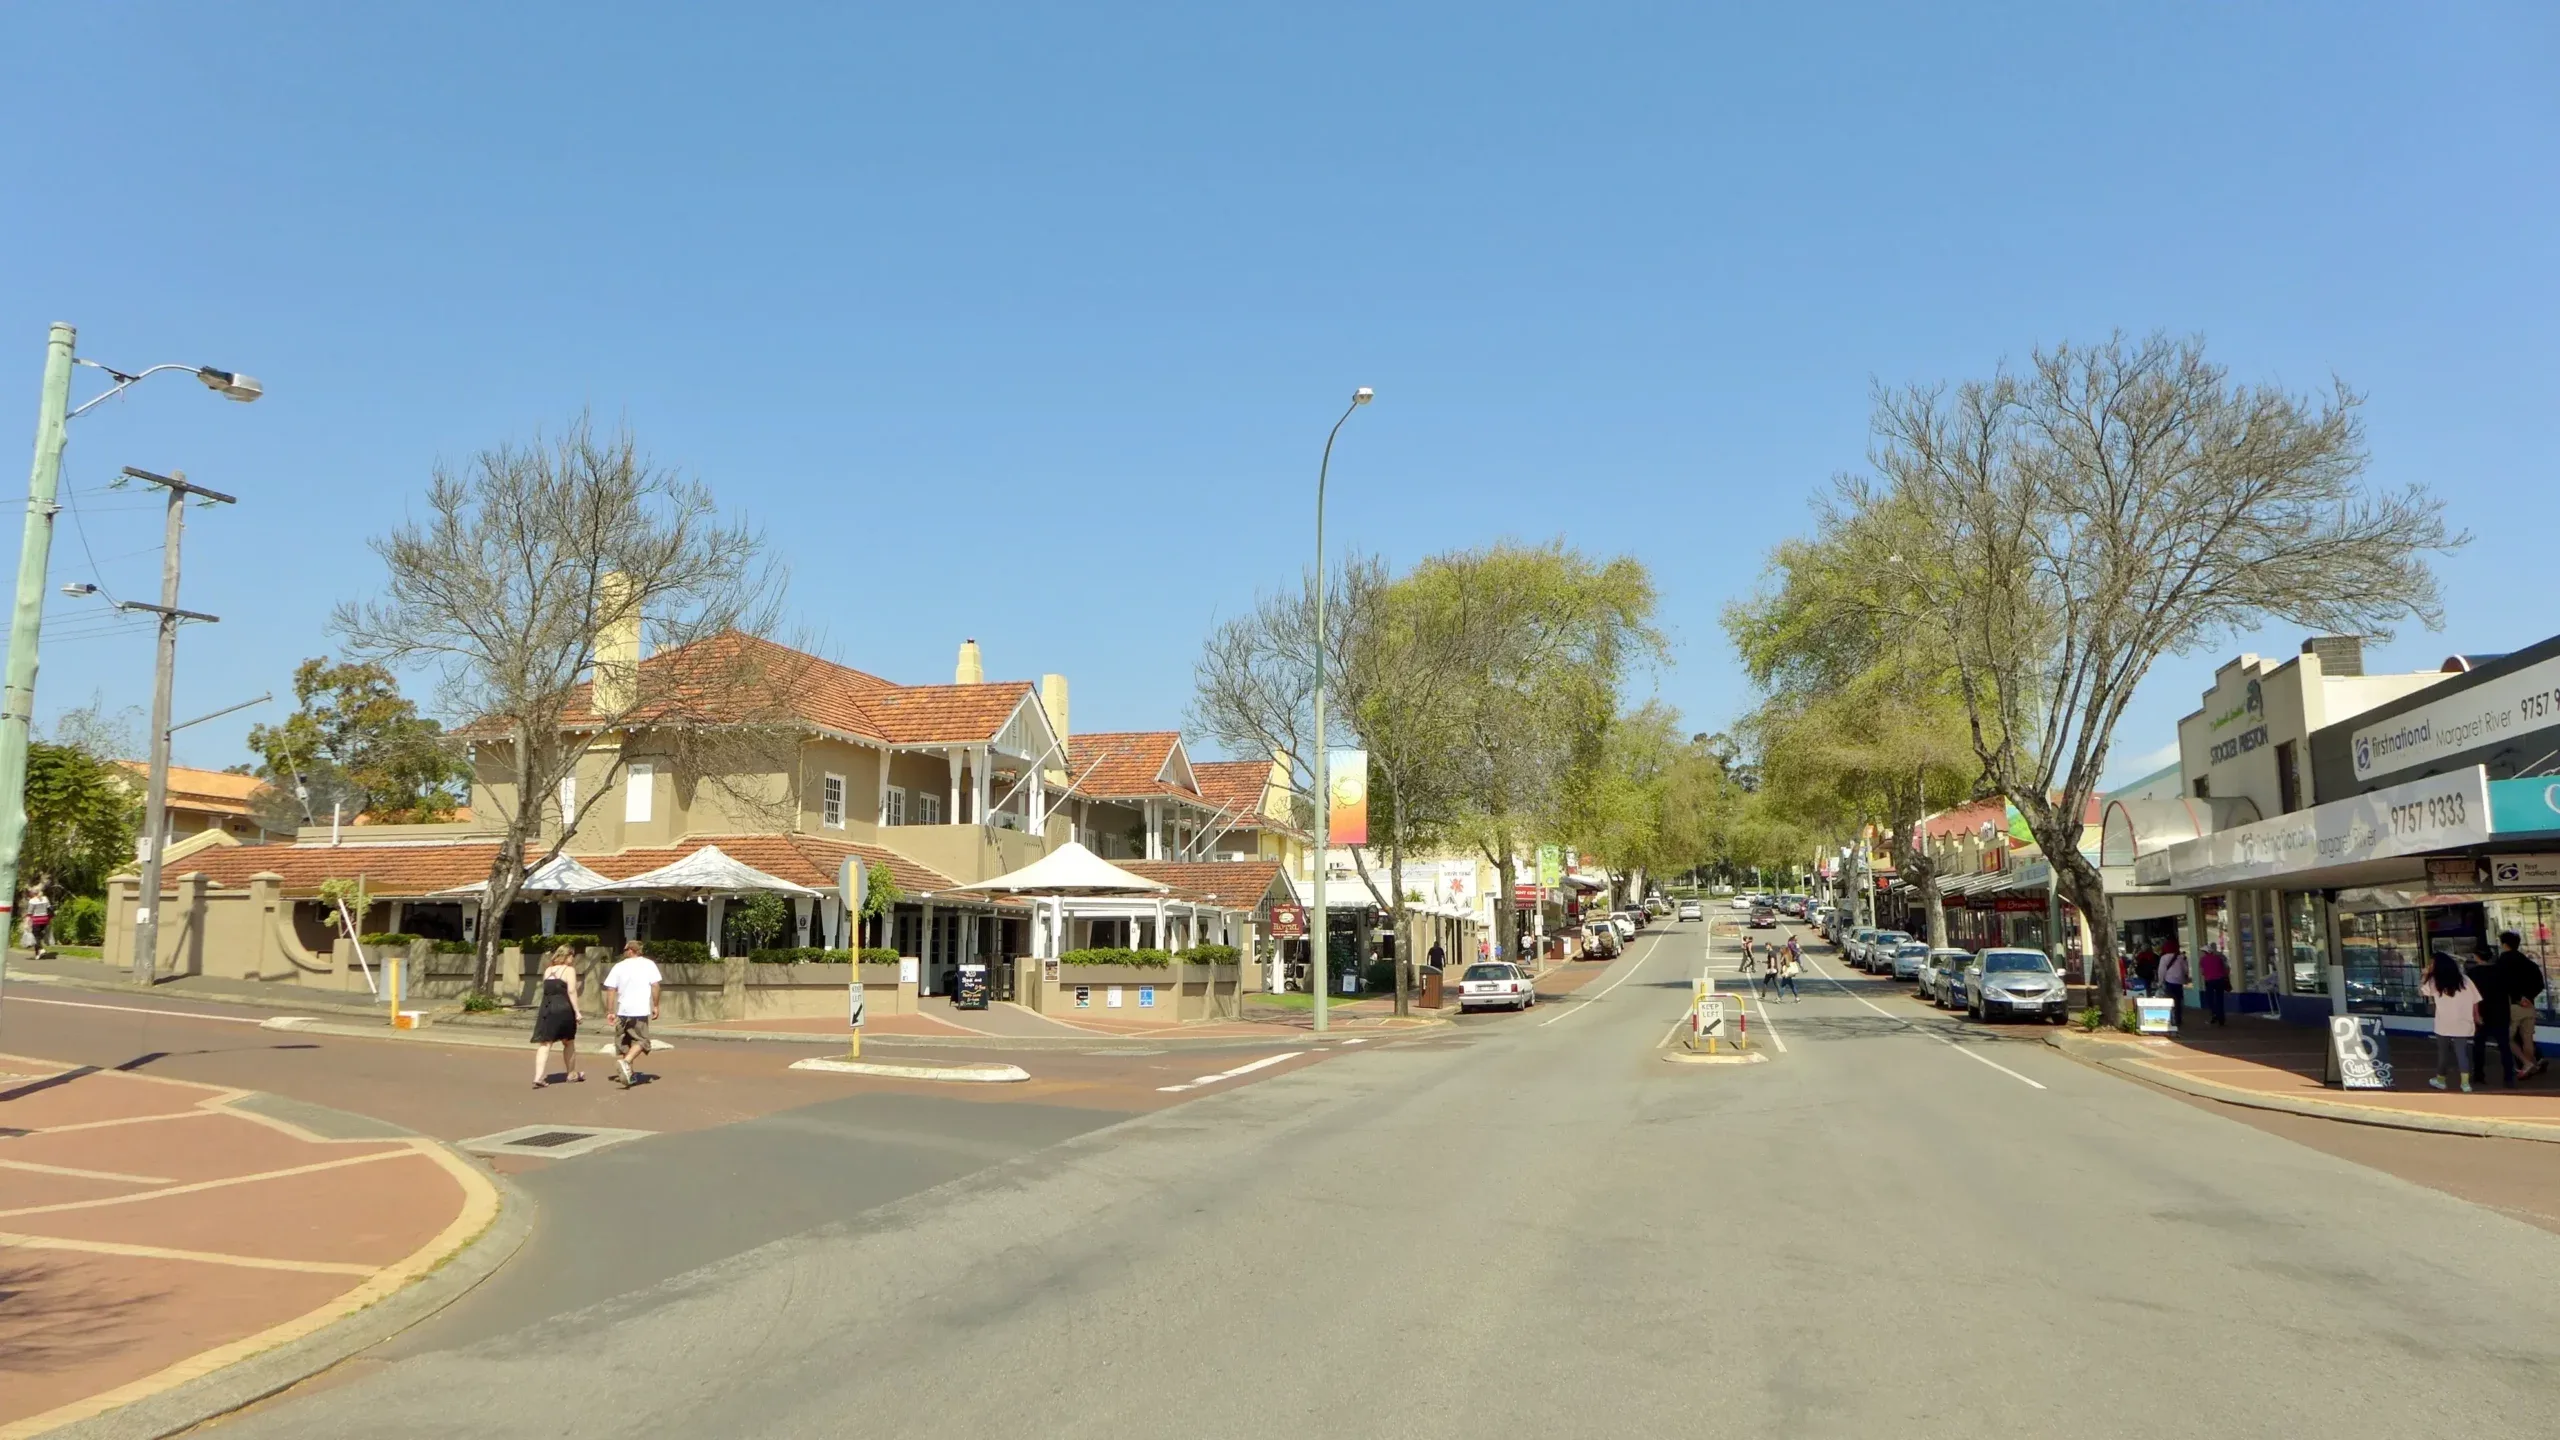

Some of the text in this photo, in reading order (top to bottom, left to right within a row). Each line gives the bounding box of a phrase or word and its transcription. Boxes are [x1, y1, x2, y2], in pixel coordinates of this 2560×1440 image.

[2238, 723, 2269, 754] PRESTON
[2435, 714, 2483, 747] Margaret
[2484, 710, 2512, 733] River
[2521, 691, 2549, 721] 9757
[2391, 801, 2424, 836] 9757
[2428, 791, 2467, 829] 9333
